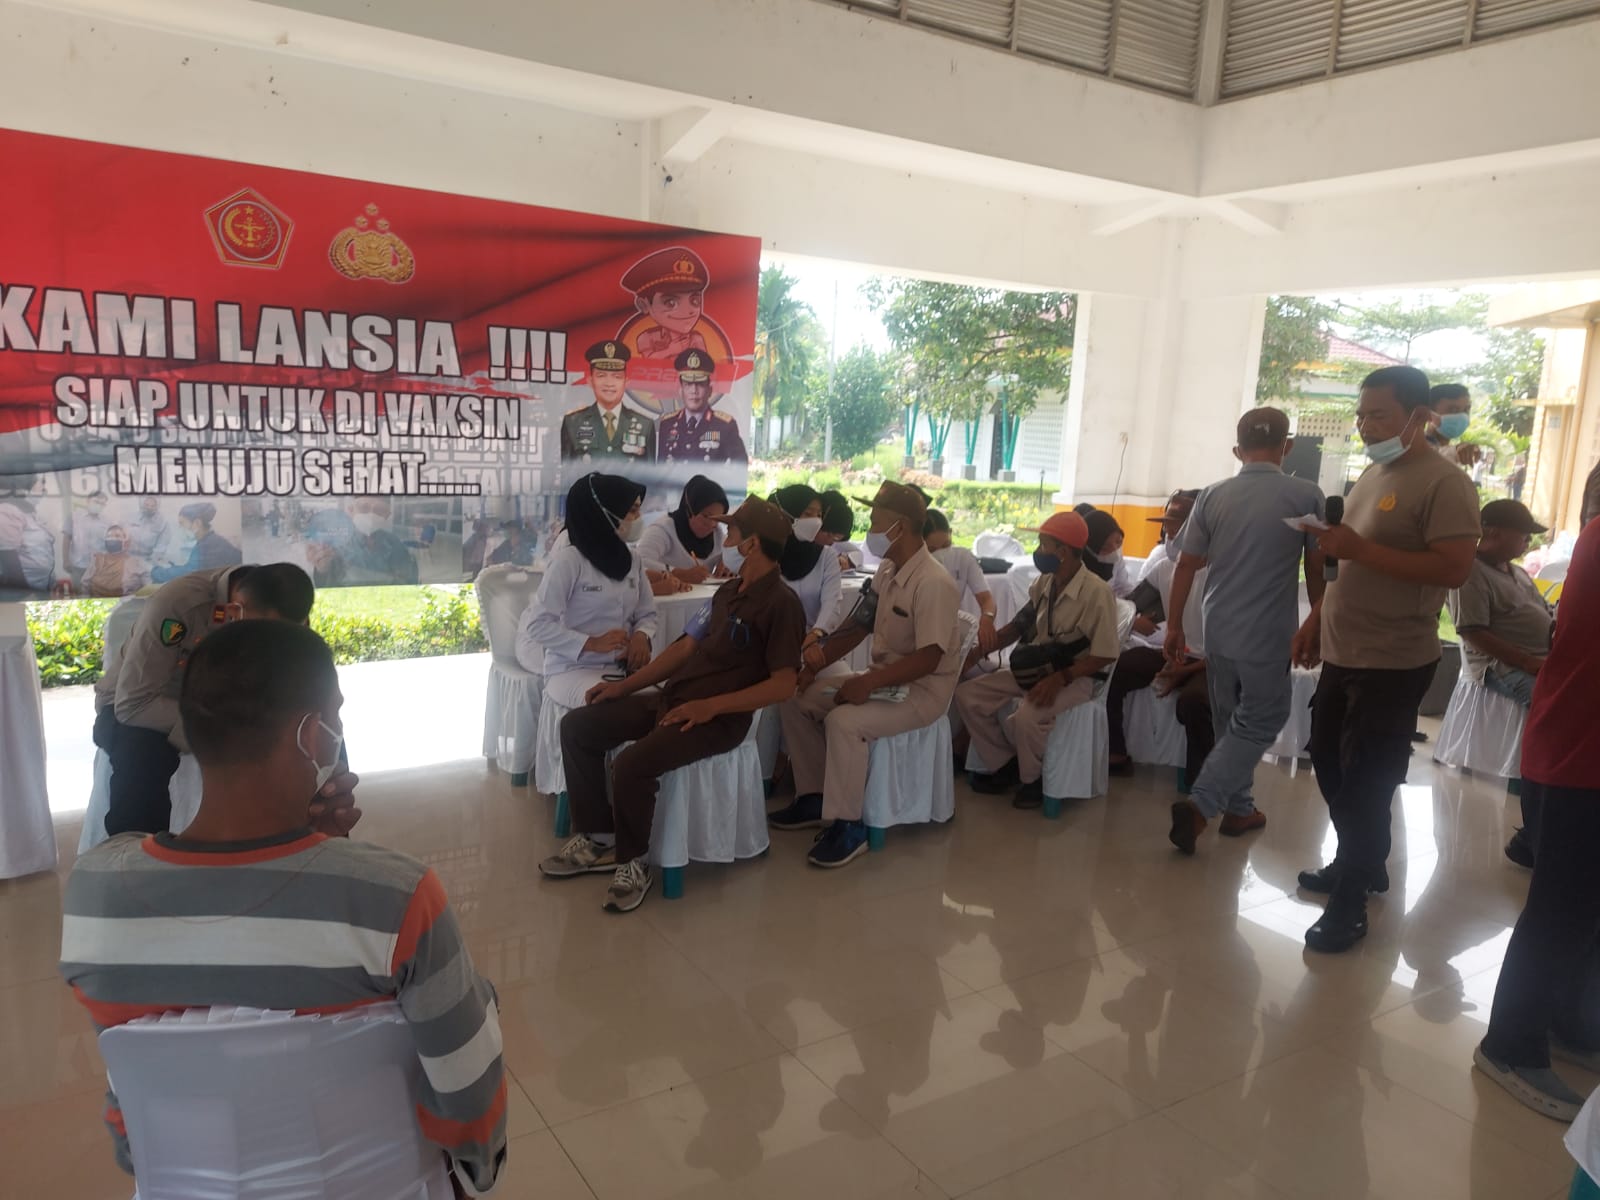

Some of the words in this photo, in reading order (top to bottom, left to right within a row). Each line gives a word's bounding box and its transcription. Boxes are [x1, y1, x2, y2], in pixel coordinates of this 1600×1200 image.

[0, 283, 197, 361] KAMI
[215, 300, 463, 377] LANSIA
[487, 325, 568, 384] !!!!
[54, 375, 169, 429] SIAP
[176, 379, 329, 434] UNTUK
[334, 389, 378, 436] DI
[382, 390, 521, 440] VAKSIN
[114, 444, 295, 496] MENUJU
